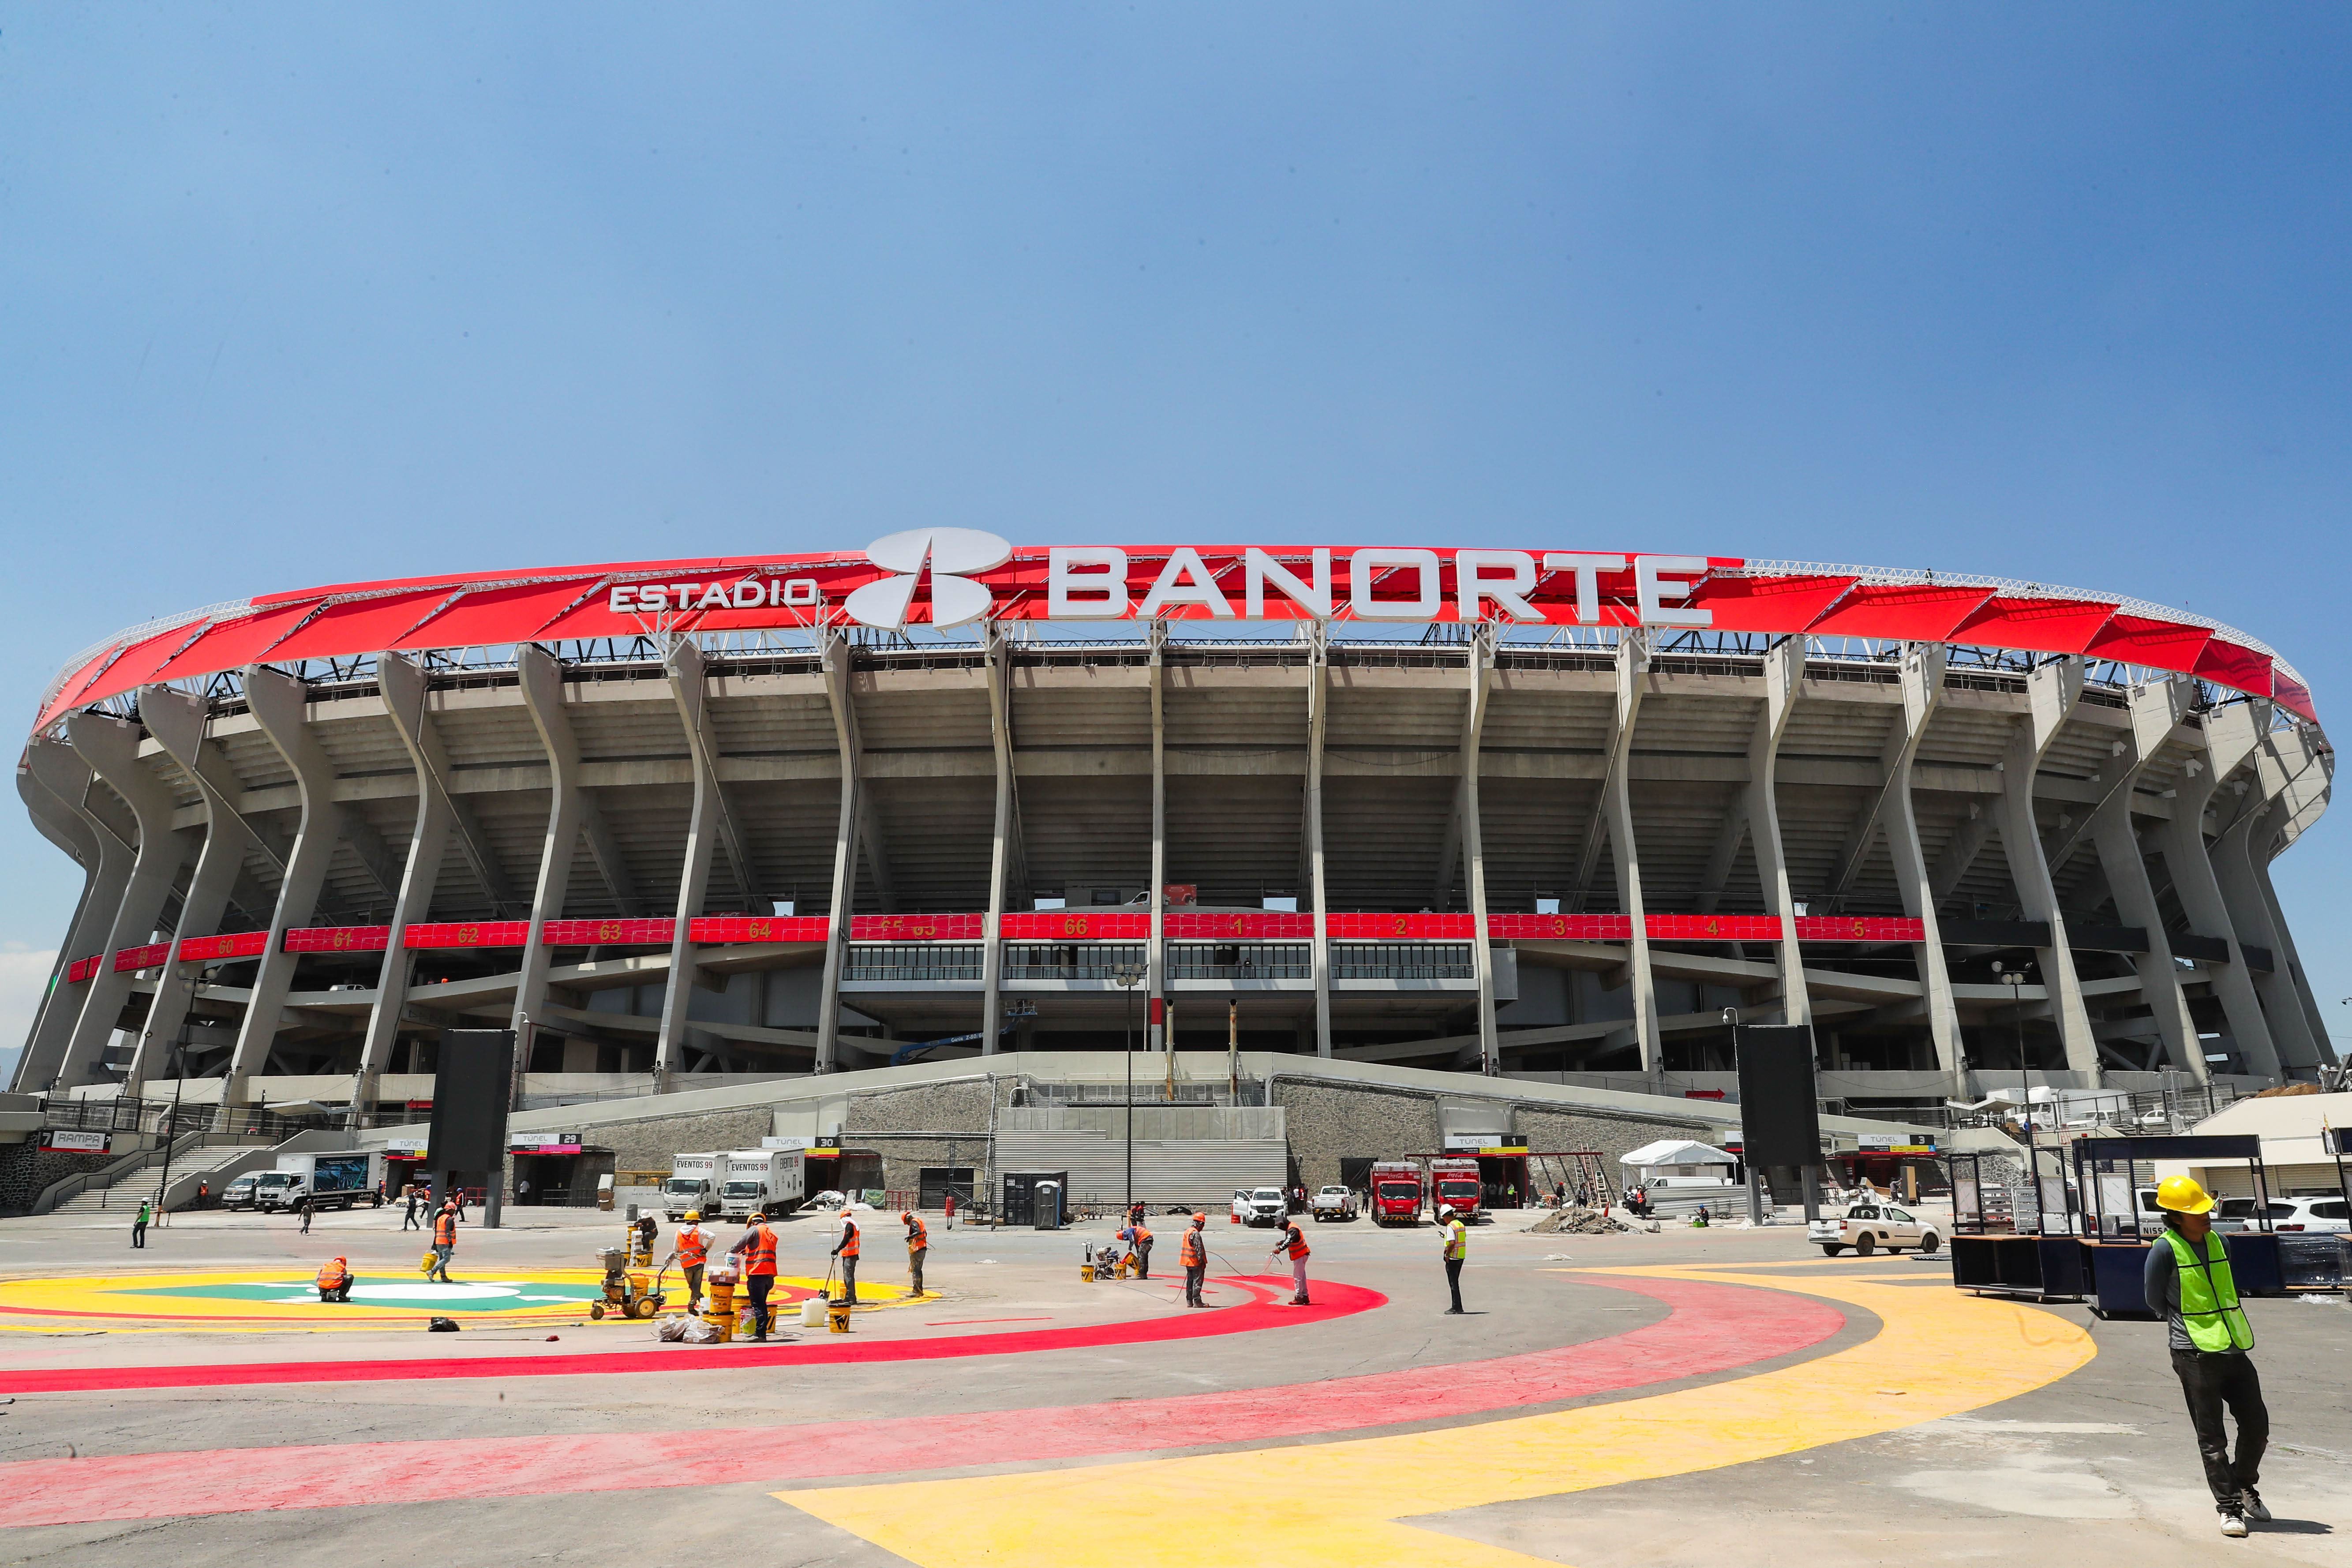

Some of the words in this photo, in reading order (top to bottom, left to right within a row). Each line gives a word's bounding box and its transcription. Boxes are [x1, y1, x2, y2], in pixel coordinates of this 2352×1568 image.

[610, 579, 817, 612] ESTADIO
[1048, 547, 1713, 628] BANORTE
[600, 924, 620, 940] 63
[749, 922, 771, 939] 64
[1064, 919, 1087, 935] 66
[1234, 918, 1242, 934] 1
[1395, 919, 1406, 935] 2
[1554, 919, 1565, 935] 3
[1708, 919, 1718, 935] 4
[1854, 921, 1864, 937] 5
[334, 932, 351, 947] 61
[459, 928, 478, 943] 62
[219, 939, 233, 954] 60
[43, 1133, 52, 1145] 7
[58, 1133, 100, 1144] RAMPA
[564, 1134, 577, 1144] 29
[820, 1138, 833, 1147] 30
[1511, 1137, 1517, 1145] 1
[1918, 1136, 1925, 1145] 3
[780, 1156, 794, 1169] EVENTOS
[794, 1156, 799, 1168] 99
